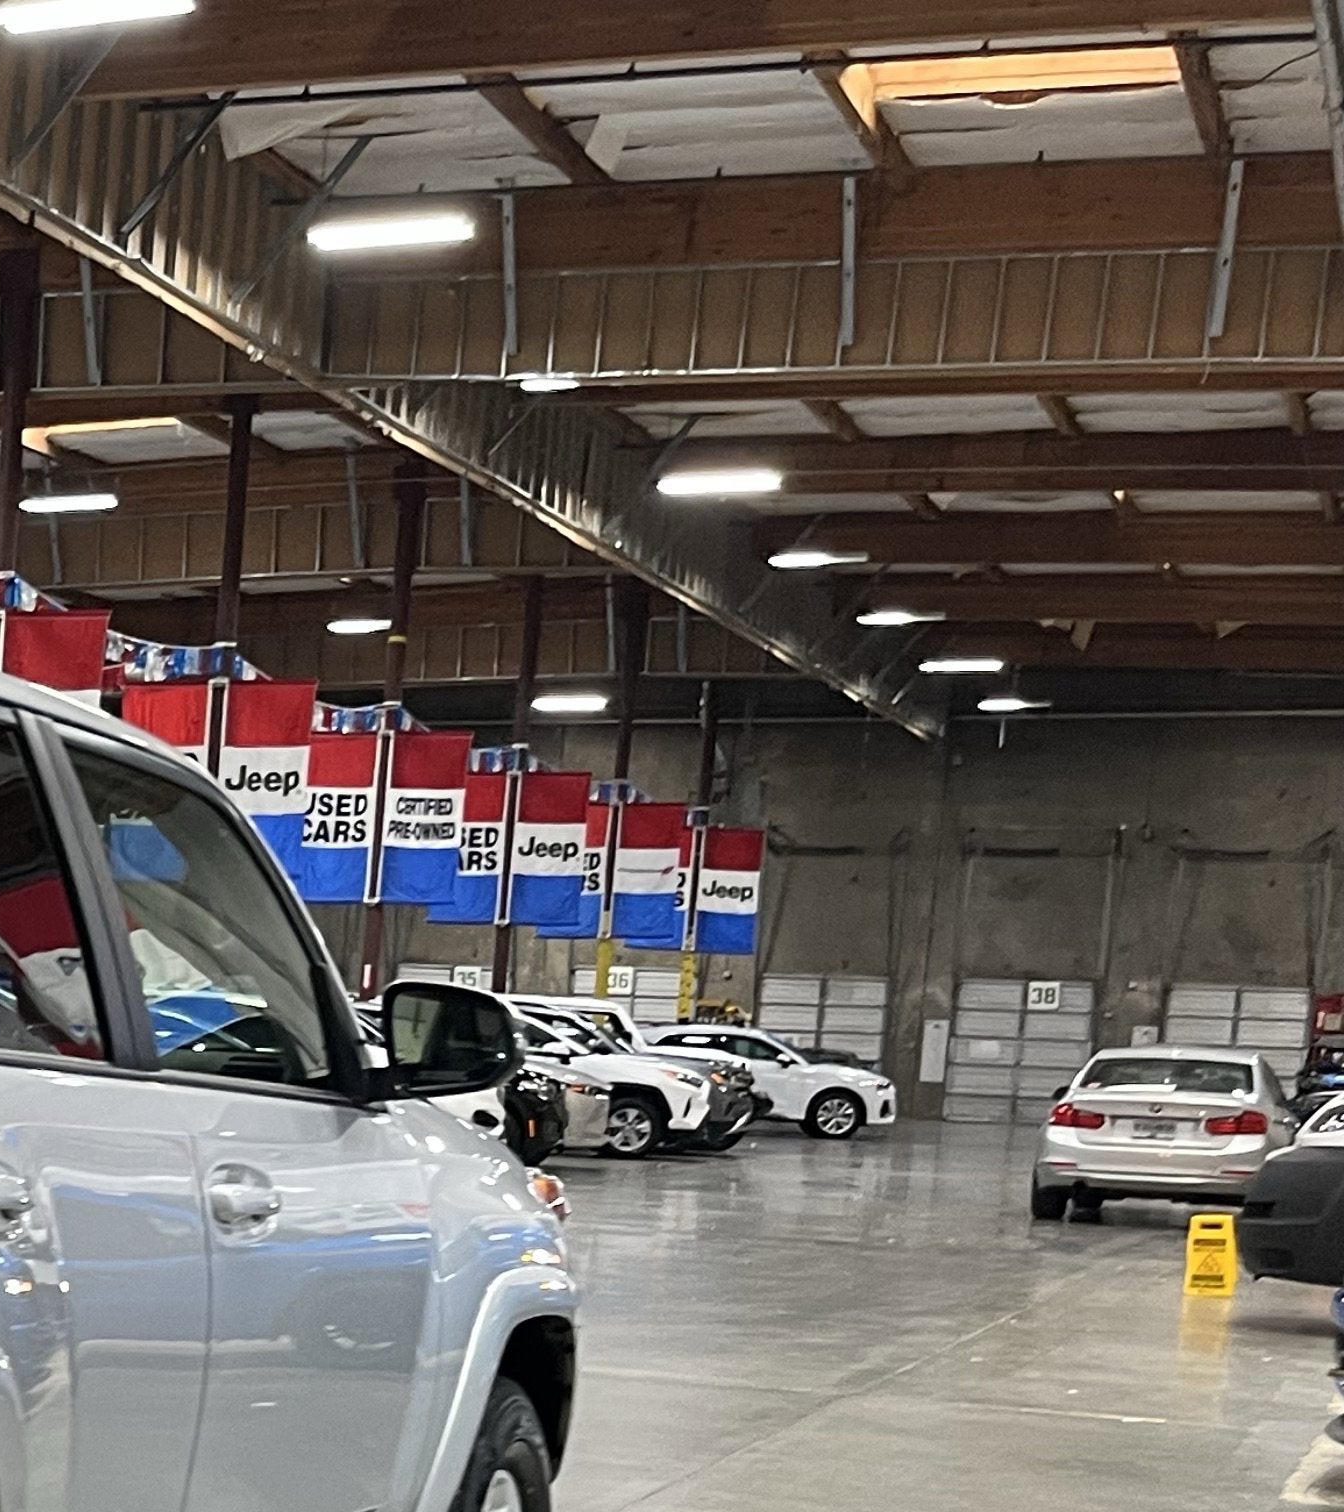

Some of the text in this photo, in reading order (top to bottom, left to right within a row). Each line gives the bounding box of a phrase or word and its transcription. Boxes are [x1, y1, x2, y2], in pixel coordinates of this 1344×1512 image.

[225, 765, 300, 797] Jeep
[460, 827, 499, 848] ED
[518, 836, 579, 862] Jeep
[458, 851, 498, 871] RS
[702, 880, 754, 902] Jeep
[1031, 987, 1056, 1004] 38
